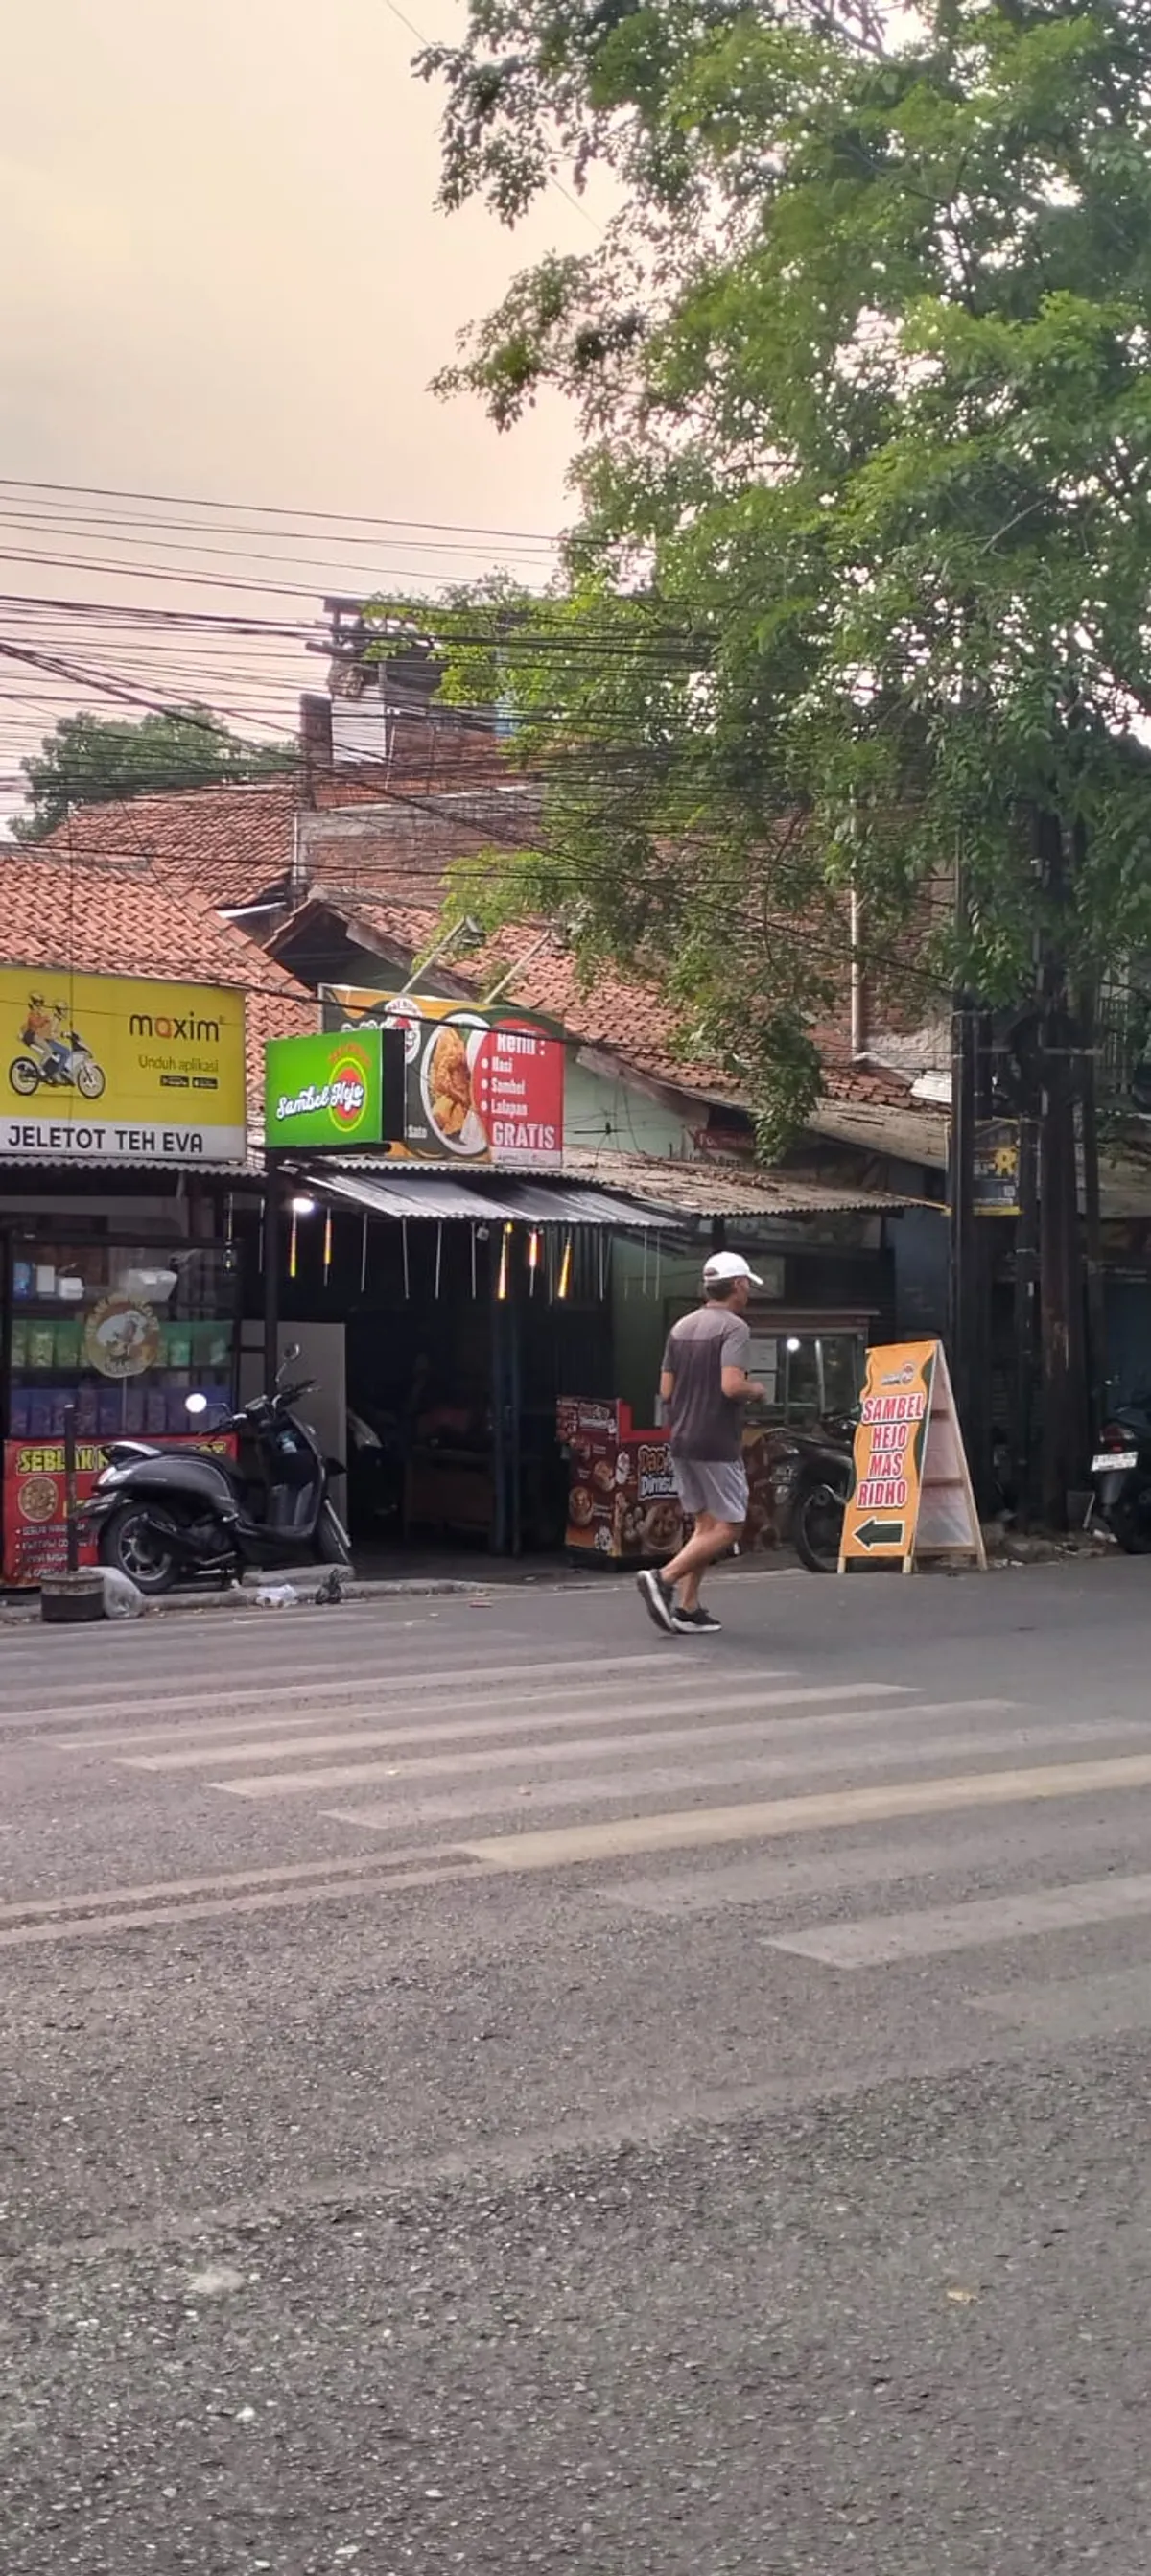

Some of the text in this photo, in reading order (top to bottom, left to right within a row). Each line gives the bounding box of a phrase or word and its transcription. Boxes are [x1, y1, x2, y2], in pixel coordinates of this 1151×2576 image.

[129, 1011, 219, 1042] maxim
[138, 1055, 219, 1073] Unduh aplikasi
[491, 1055, 513, 1073] Nasi
[491, 1076, 526, 1095] Sambel
[275, 1080, 364, 1121] Sambel Hejo
[490, 1098, 528, 1119] Lalapan
[8, 1125, 203, 1153] JELETOT TEH EVA
[492, 1121, 555, 1149] GRATIS
[862, 1394, 923, 1423] SAMBEL
[871, 1424, 908, 1451] HEJO
[868, 1453, 904, 1480] MAS
[857, 1481, 907, 1509] RIDHO
